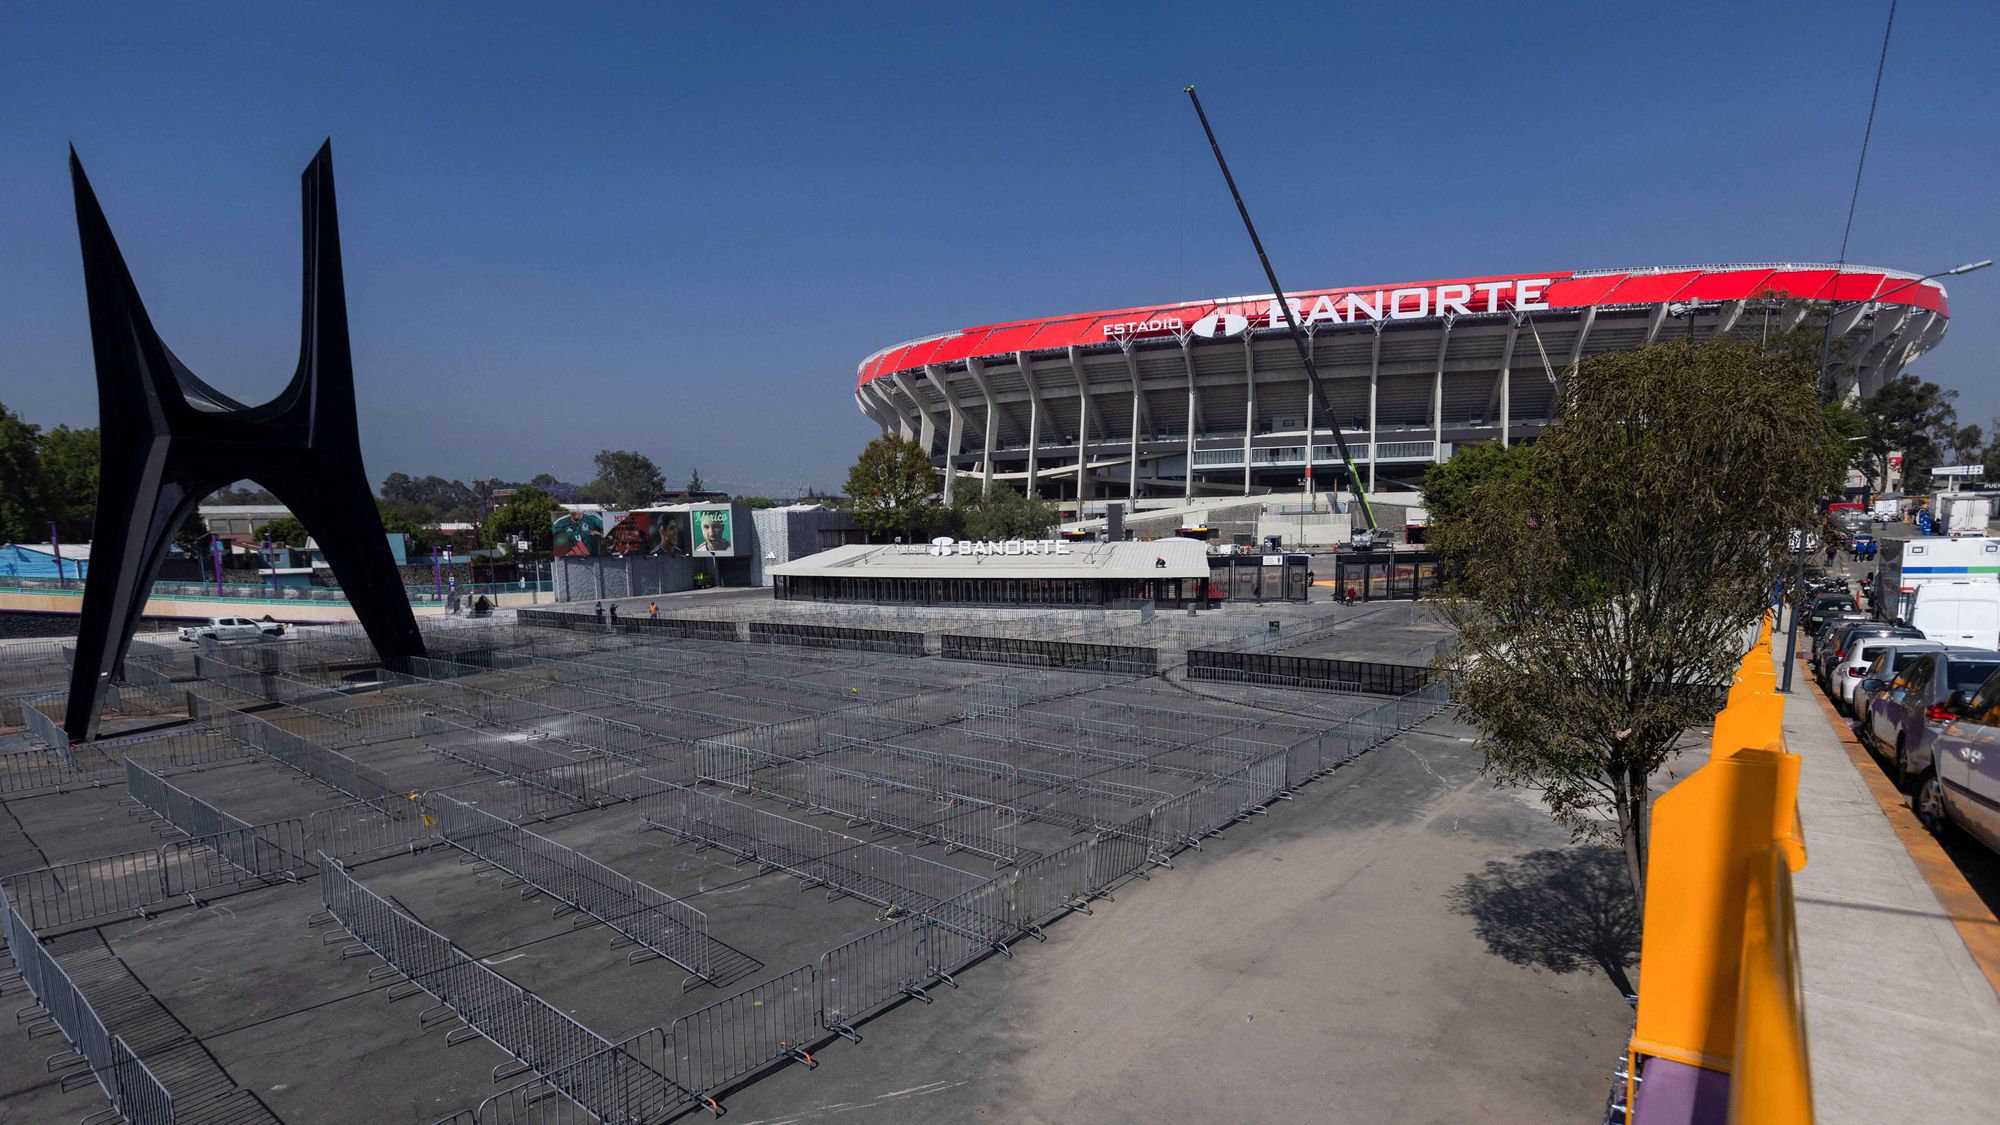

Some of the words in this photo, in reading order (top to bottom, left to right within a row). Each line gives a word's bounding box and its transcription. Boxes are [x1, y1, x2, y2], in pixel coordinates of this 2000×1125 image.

[1103, 318, 1181, 336] ESTADIO
[1269, 278, 1550, 329] BANORTE
[695, 511, 728, 523] México
[958, 539, 1070, 555] BANORTE
